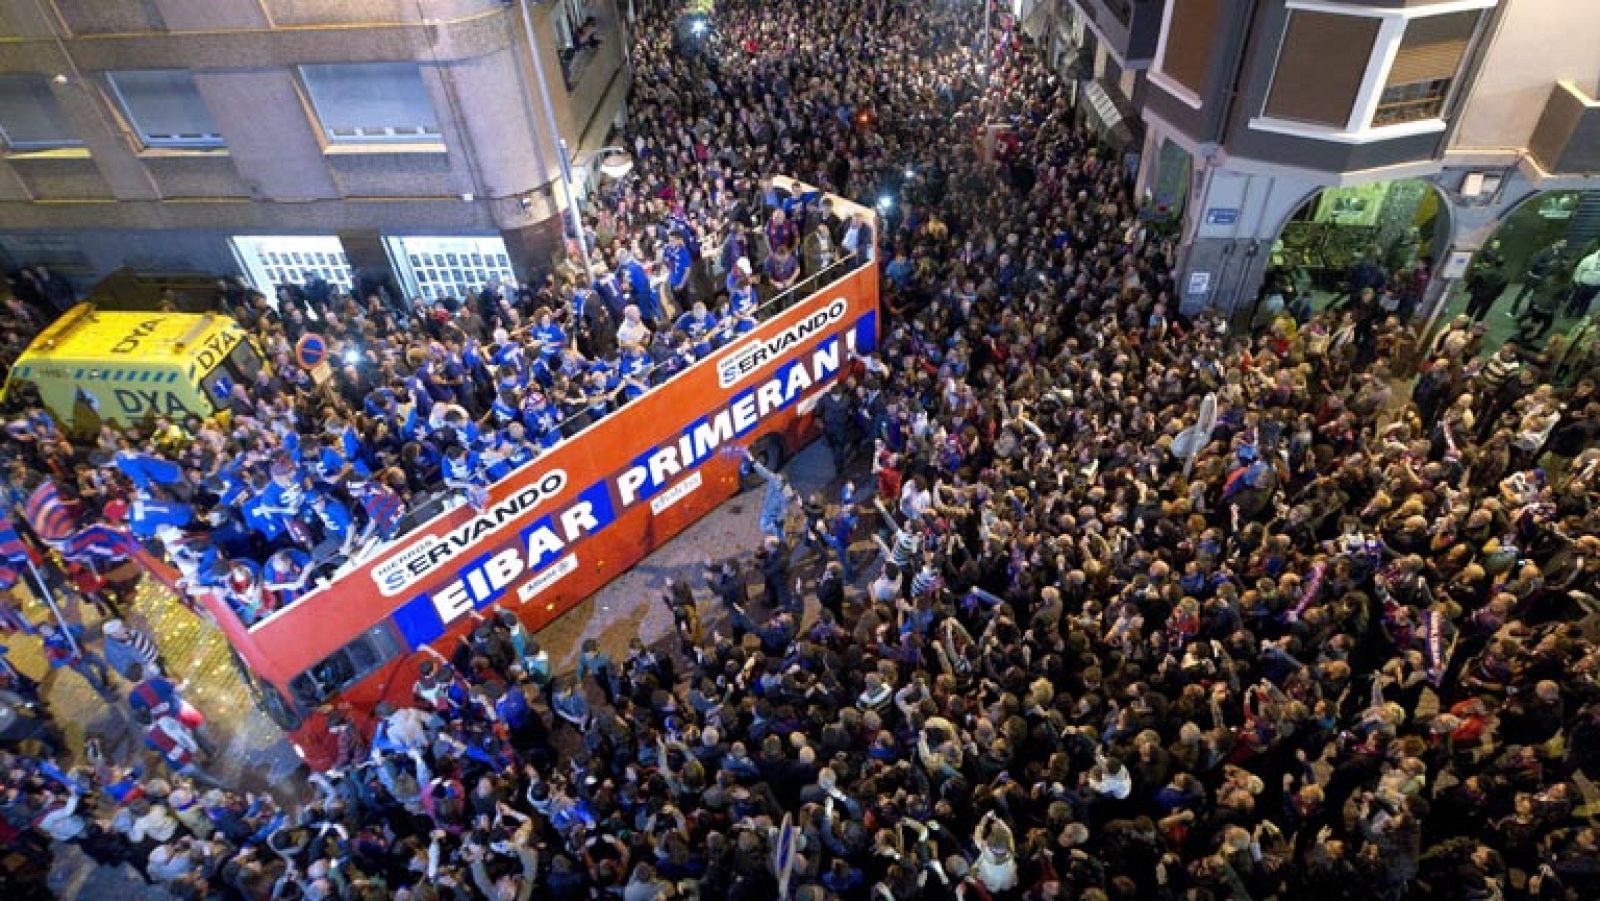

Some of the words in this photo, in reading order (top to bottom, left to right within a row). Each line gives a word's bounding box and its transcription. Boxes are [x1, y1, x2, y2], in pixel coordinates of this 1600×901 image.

[111, 316, 164, 354] DYA
[197, 331, 237, 371] DYA
[113, 389, 190, 413] DYA
[432, 500, 599, 624] EIBAR
